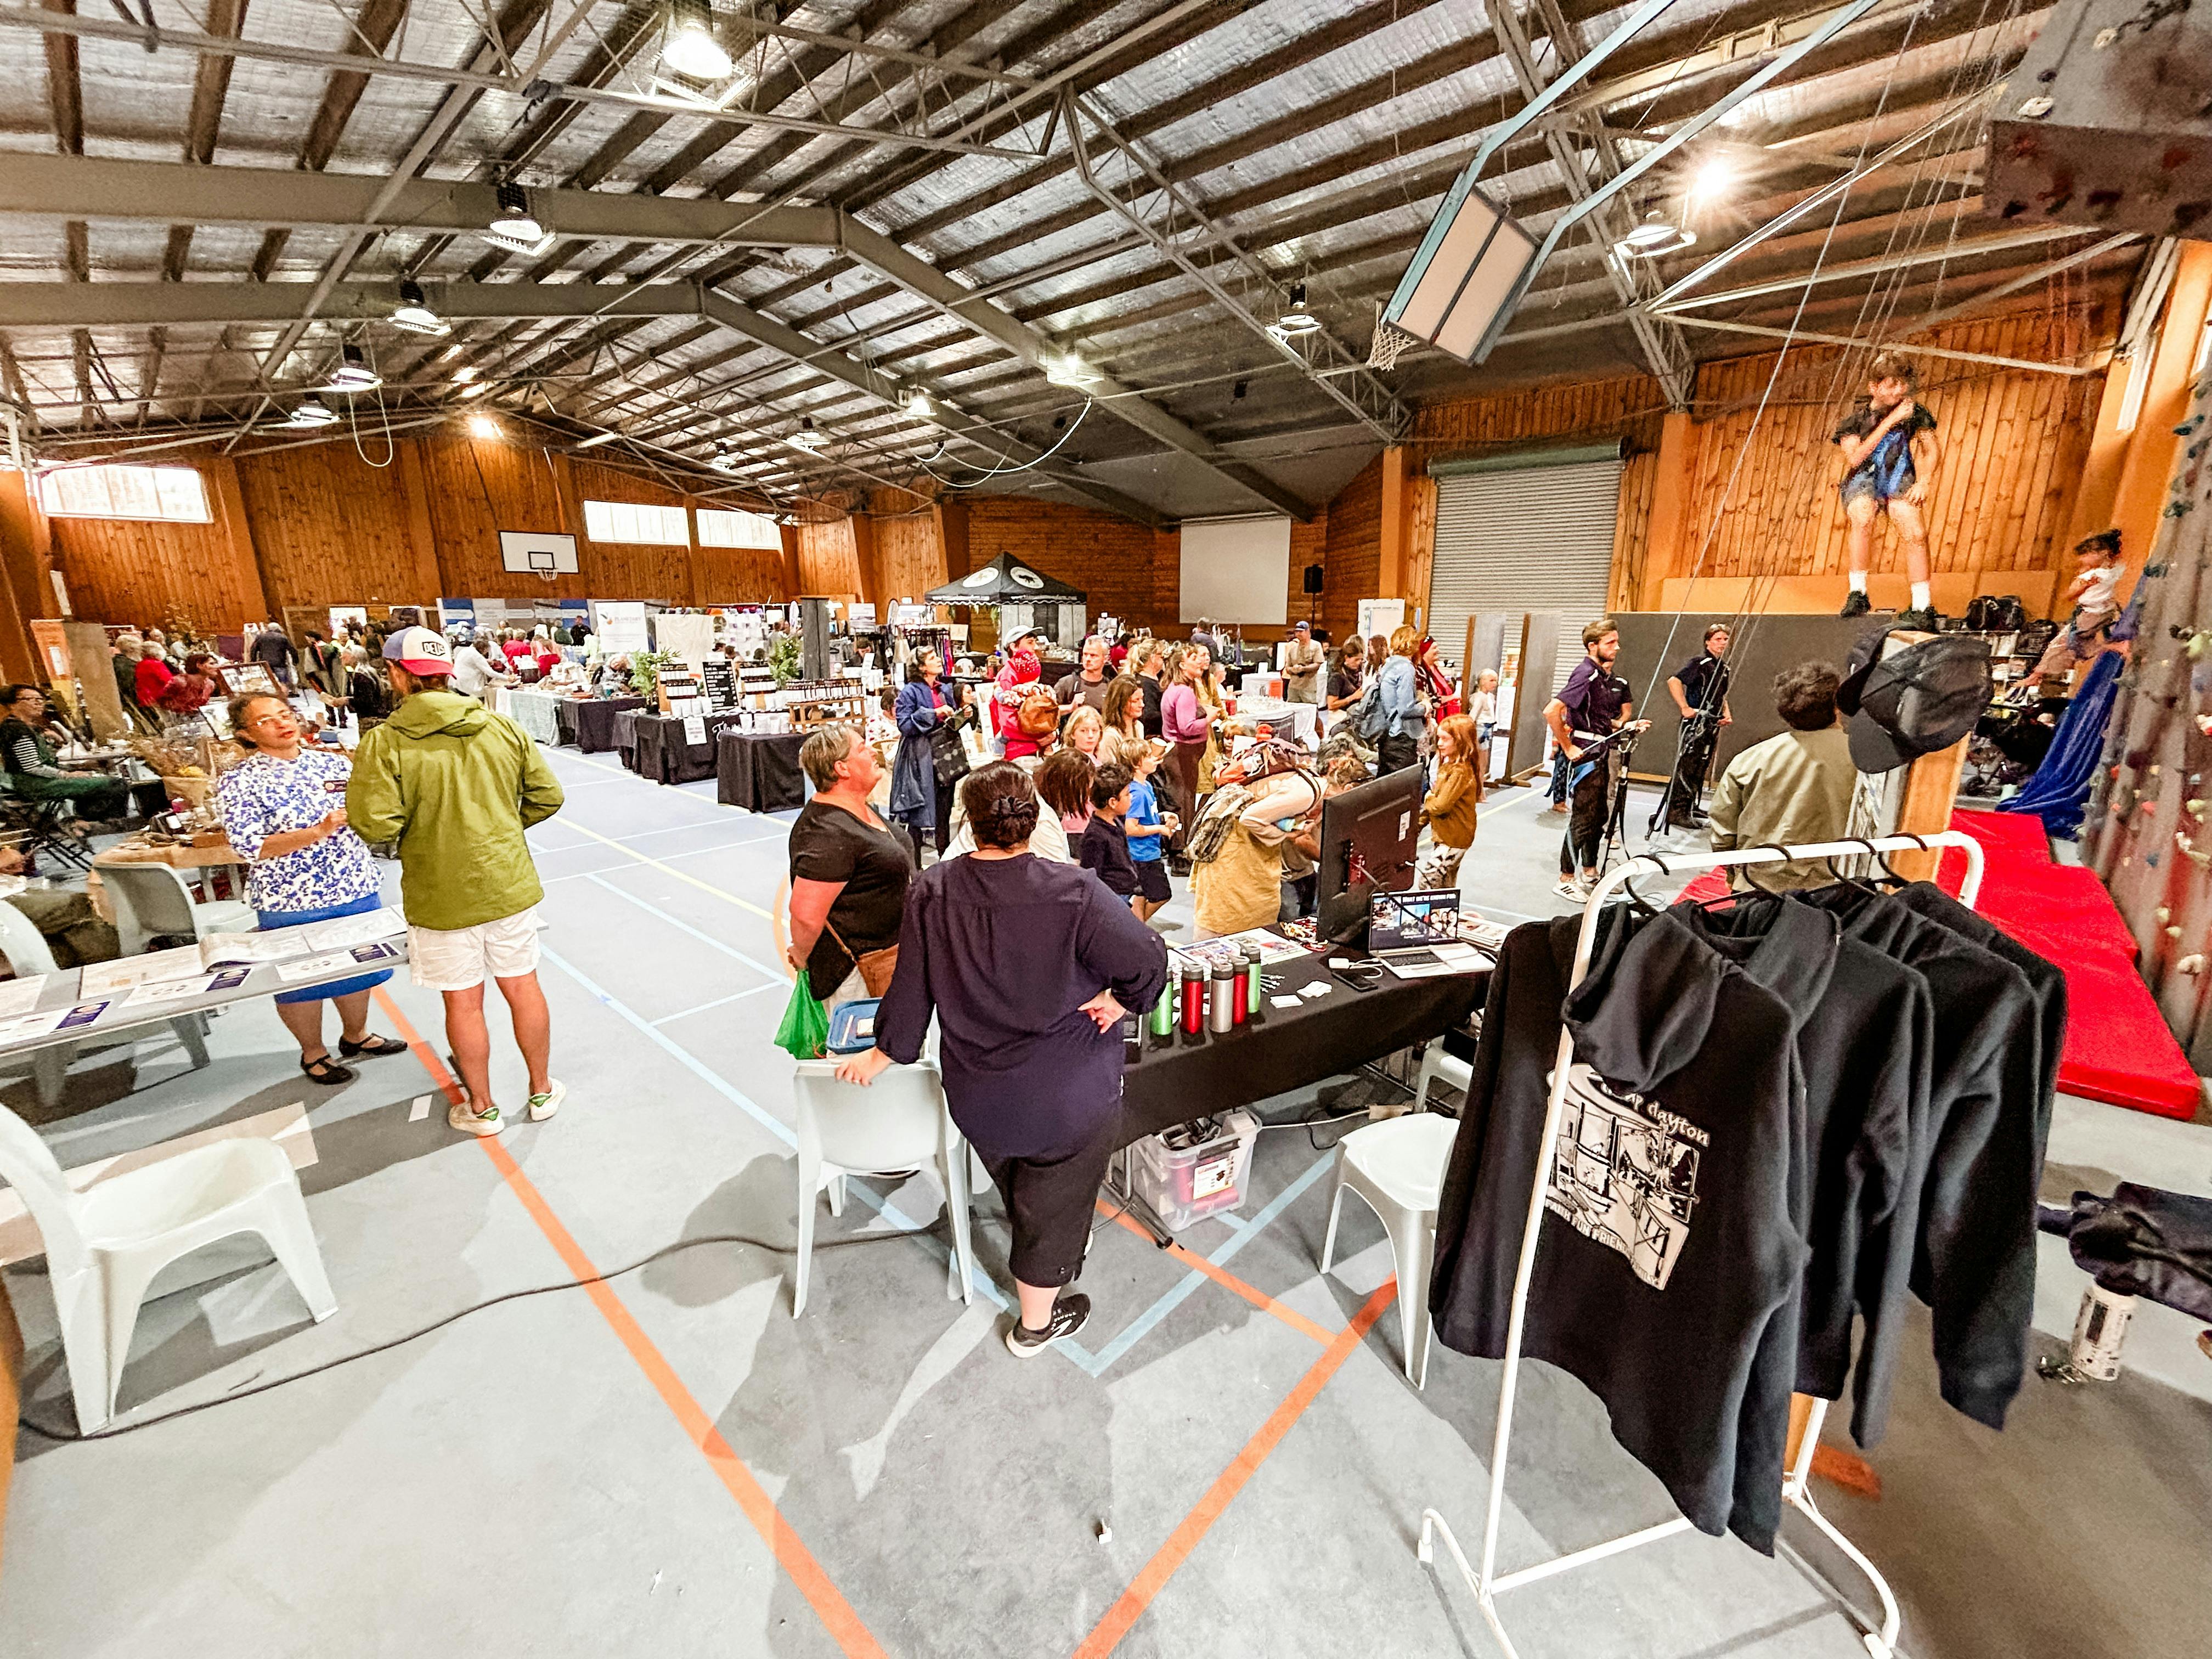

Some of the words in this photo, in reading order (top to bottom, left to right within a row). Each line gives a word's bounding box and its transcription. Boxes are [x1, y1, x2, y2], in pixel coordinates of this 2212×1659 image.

[1647, 1099, 1710, 1147] dayton
[1545, 1198, 1571, 1222] FAITH
[1571, 1215, 1591, 1237] FUN
